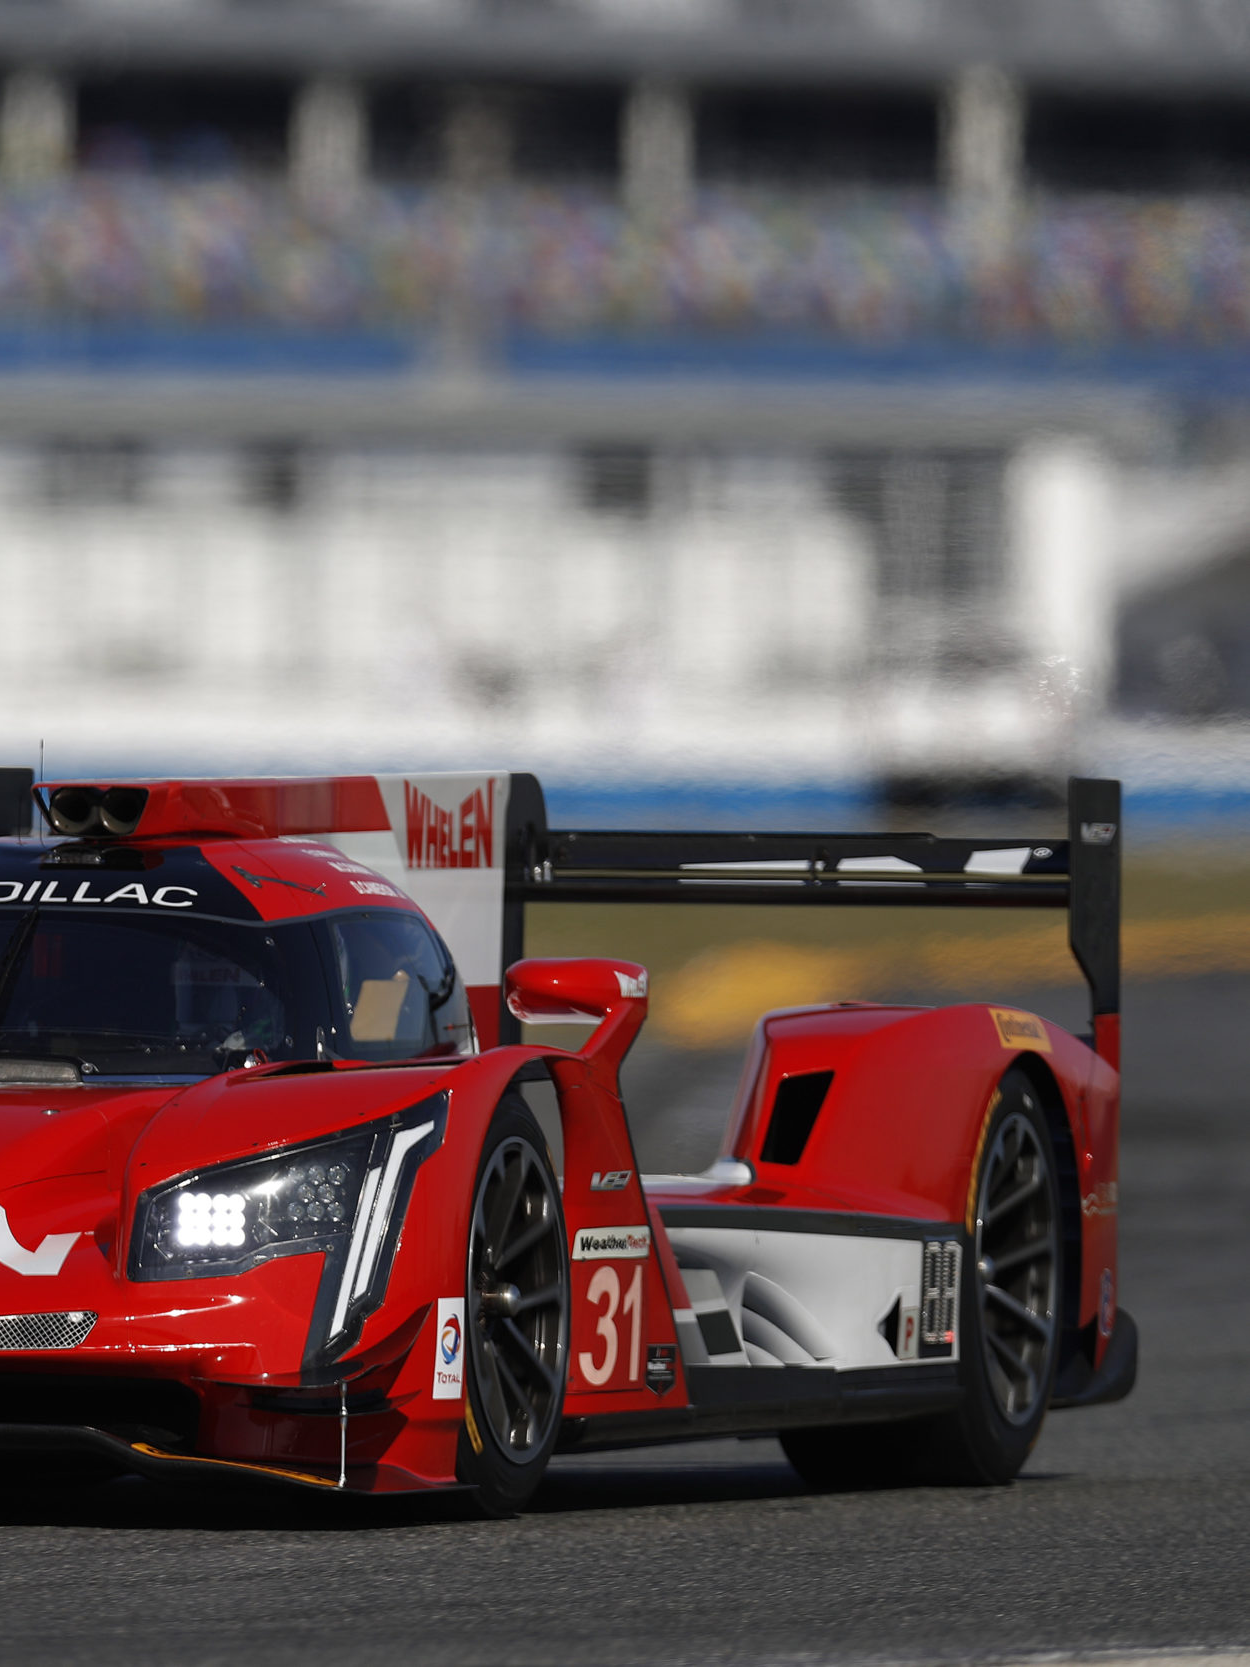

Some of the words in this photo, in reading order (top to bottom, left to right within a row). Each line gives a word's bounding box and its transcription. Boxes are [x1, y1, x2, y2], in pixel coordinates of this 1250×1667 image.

[403, 777, 497, 869] WHELEN
[580, 1234, 647, 1251] WeatherTech
[578, 1265, 642, 1386] 31
[437, 1371, 461, 1384] TOTAL
